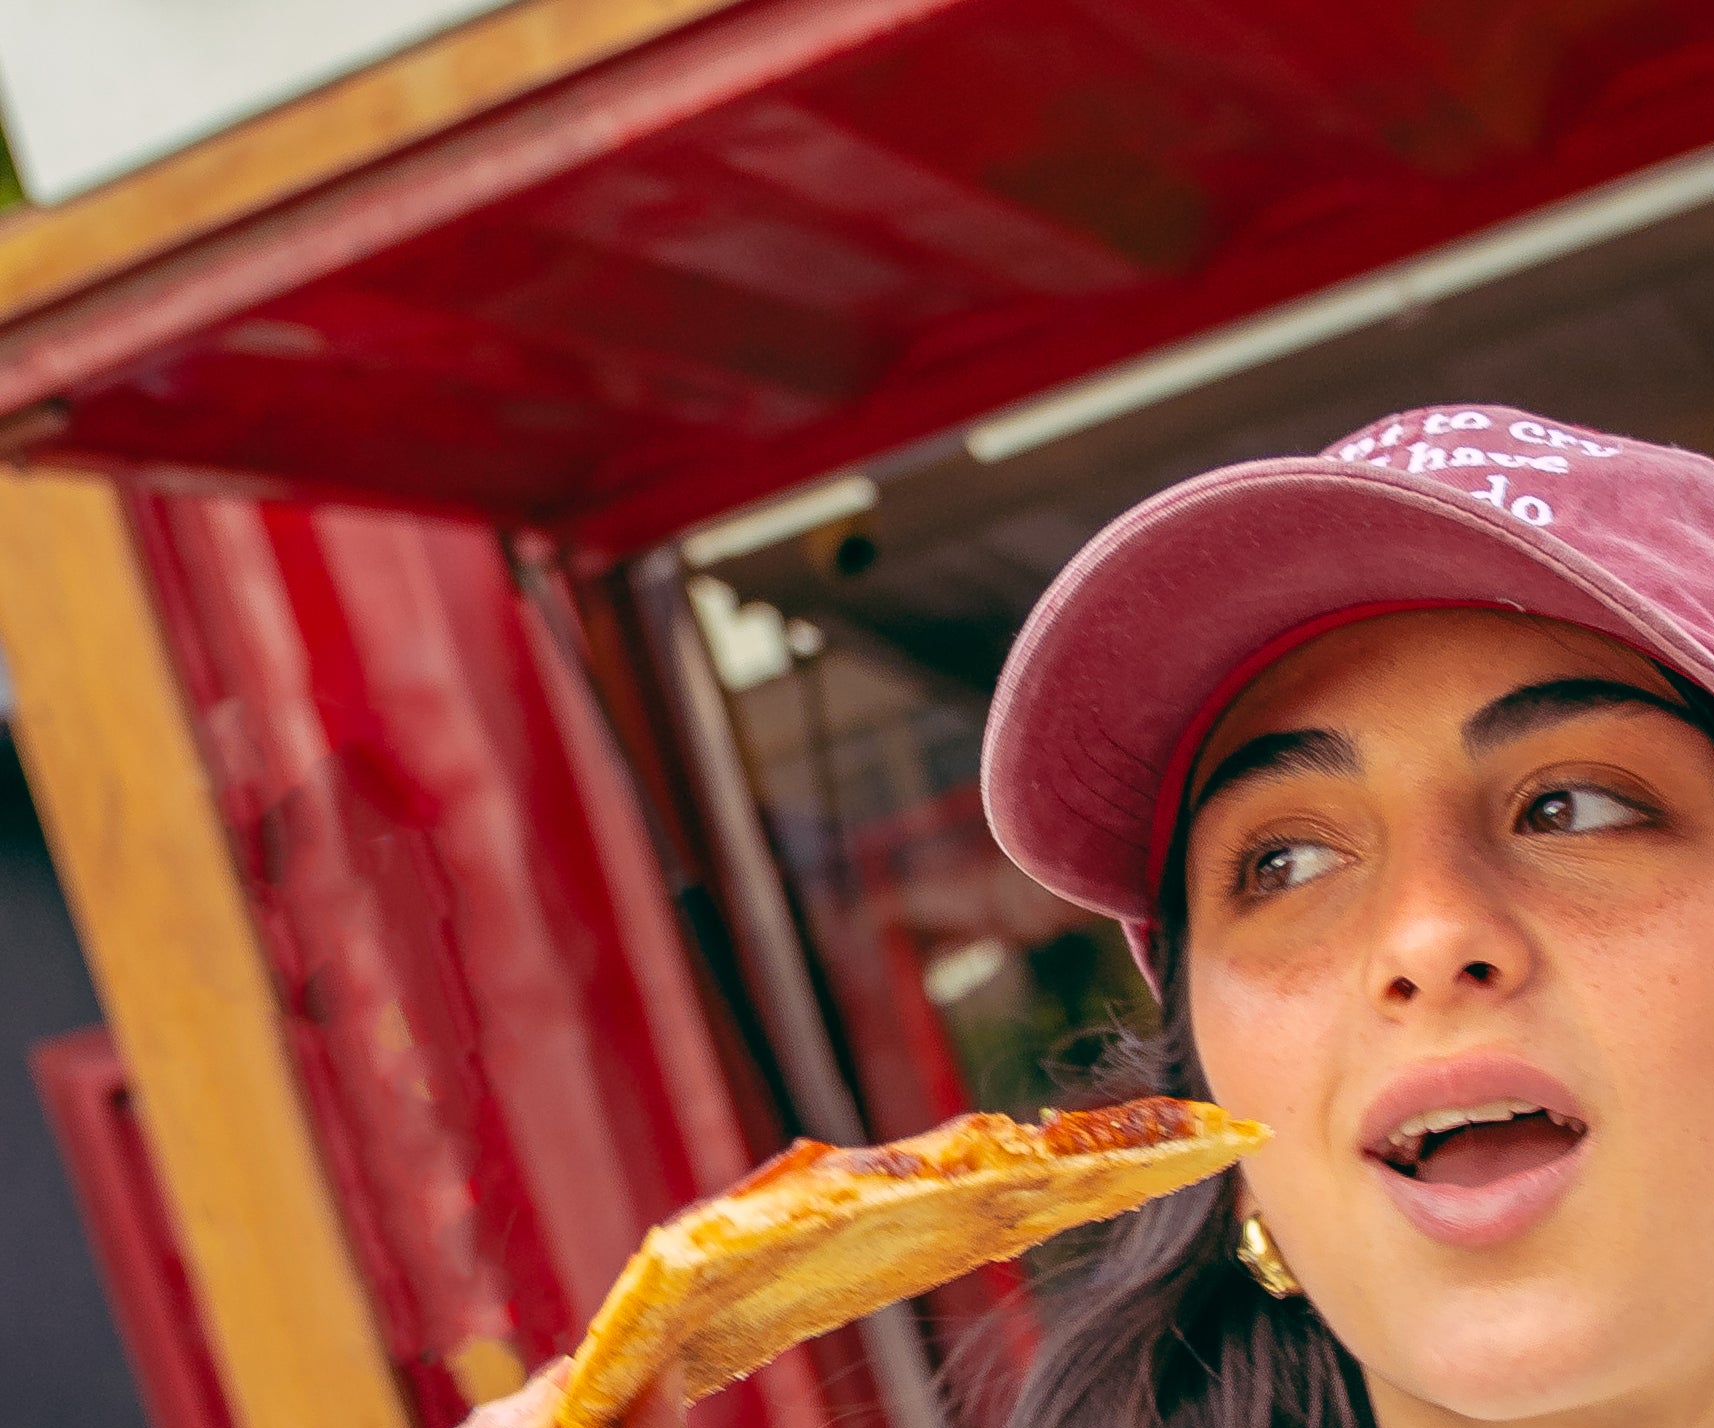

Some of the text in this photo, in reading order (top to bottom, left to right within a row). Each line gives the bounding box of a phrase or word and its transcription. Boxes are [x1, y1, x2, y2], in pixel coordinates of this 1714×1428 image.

[1406, 441, 1569, 474] have
[1423, 411, 1491, 435] to
[1508, 421, 1622, 458] cry
[1469, 474, 1554, 527] do
